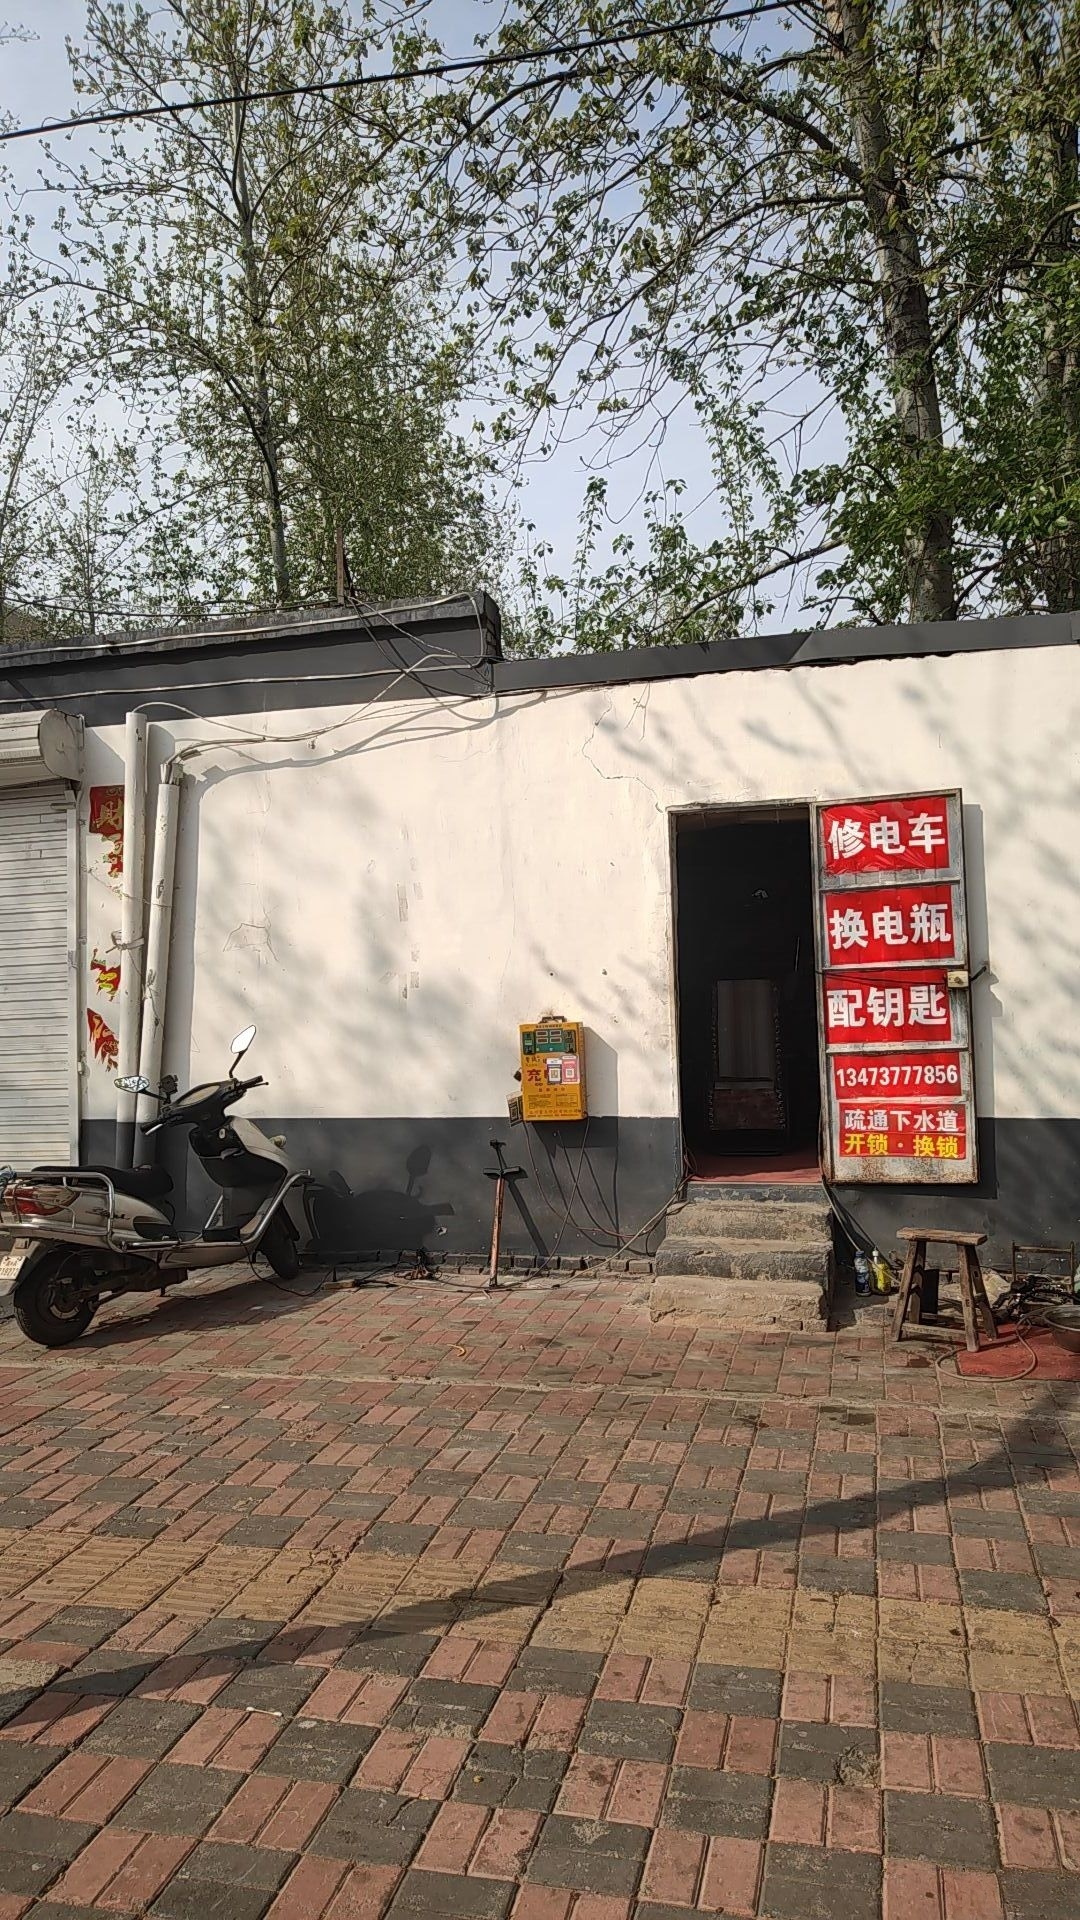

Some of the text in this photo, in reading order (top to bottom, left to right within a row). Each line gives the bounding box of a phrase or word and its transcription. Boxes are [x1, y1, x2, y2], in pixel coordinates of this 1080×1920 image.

[826, 813, 946, 860] 修电车
[829, 902, 952, 950] 换电瓶
[826, 984, 947, 1028] 配钥匙
[836, 1064, 958, 1087] 13473777856
[844, 1108, 959, 1132] 疏通下水道
